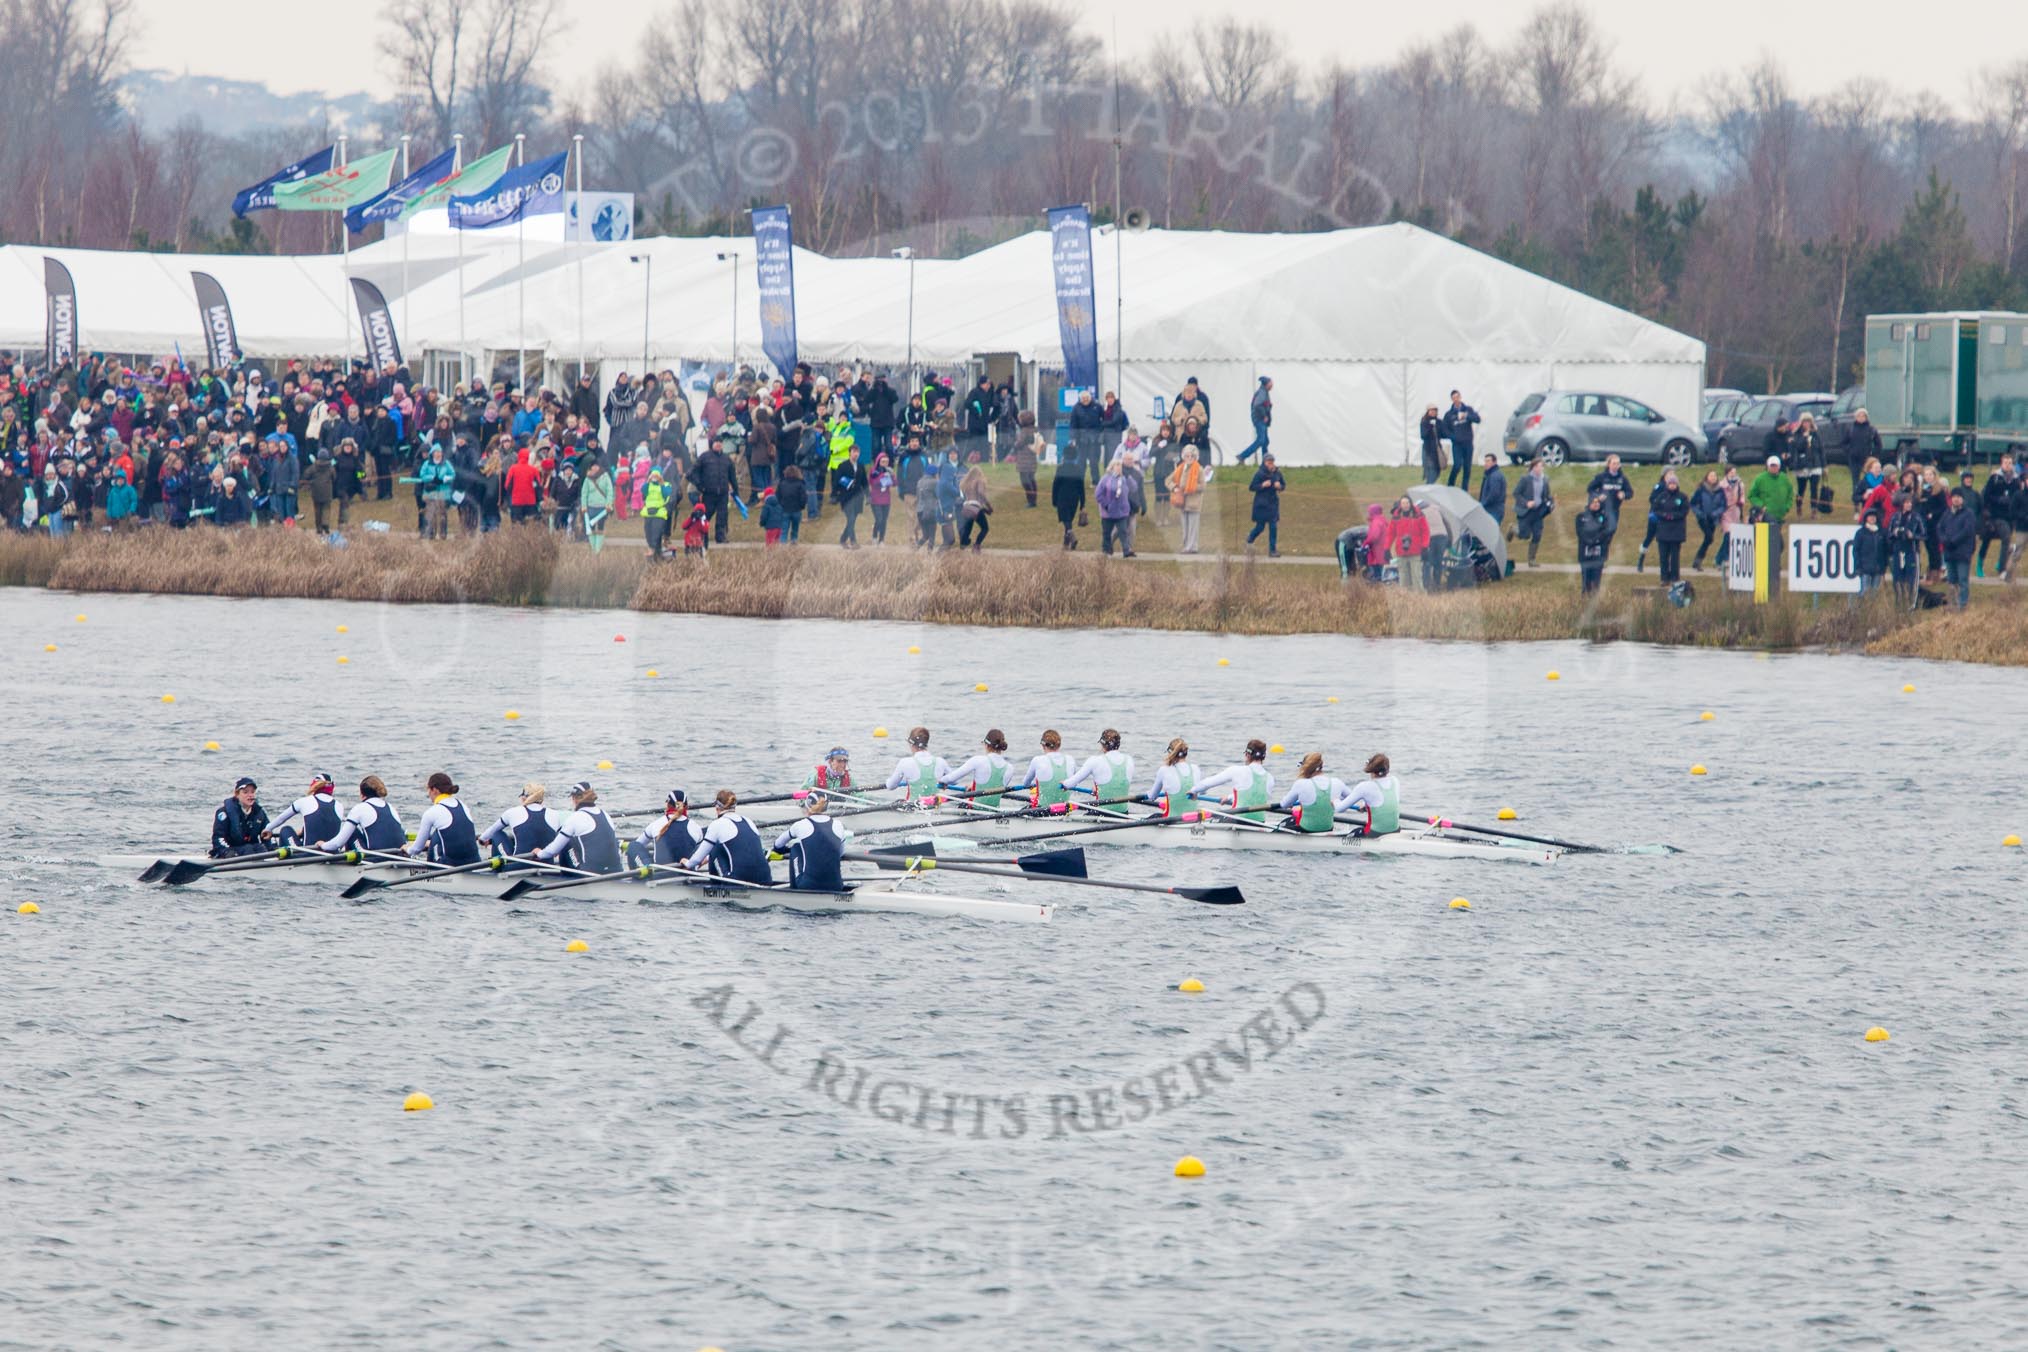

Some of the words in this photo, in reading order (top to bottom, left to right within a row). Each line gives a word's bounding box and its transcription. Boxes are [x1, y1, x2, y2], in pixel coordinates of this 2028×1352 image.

[1730, 538, 1754, 579] 1500
[1793, 538, 1857, 579] 1500
[702, 886, 731, 899] NEWTON
